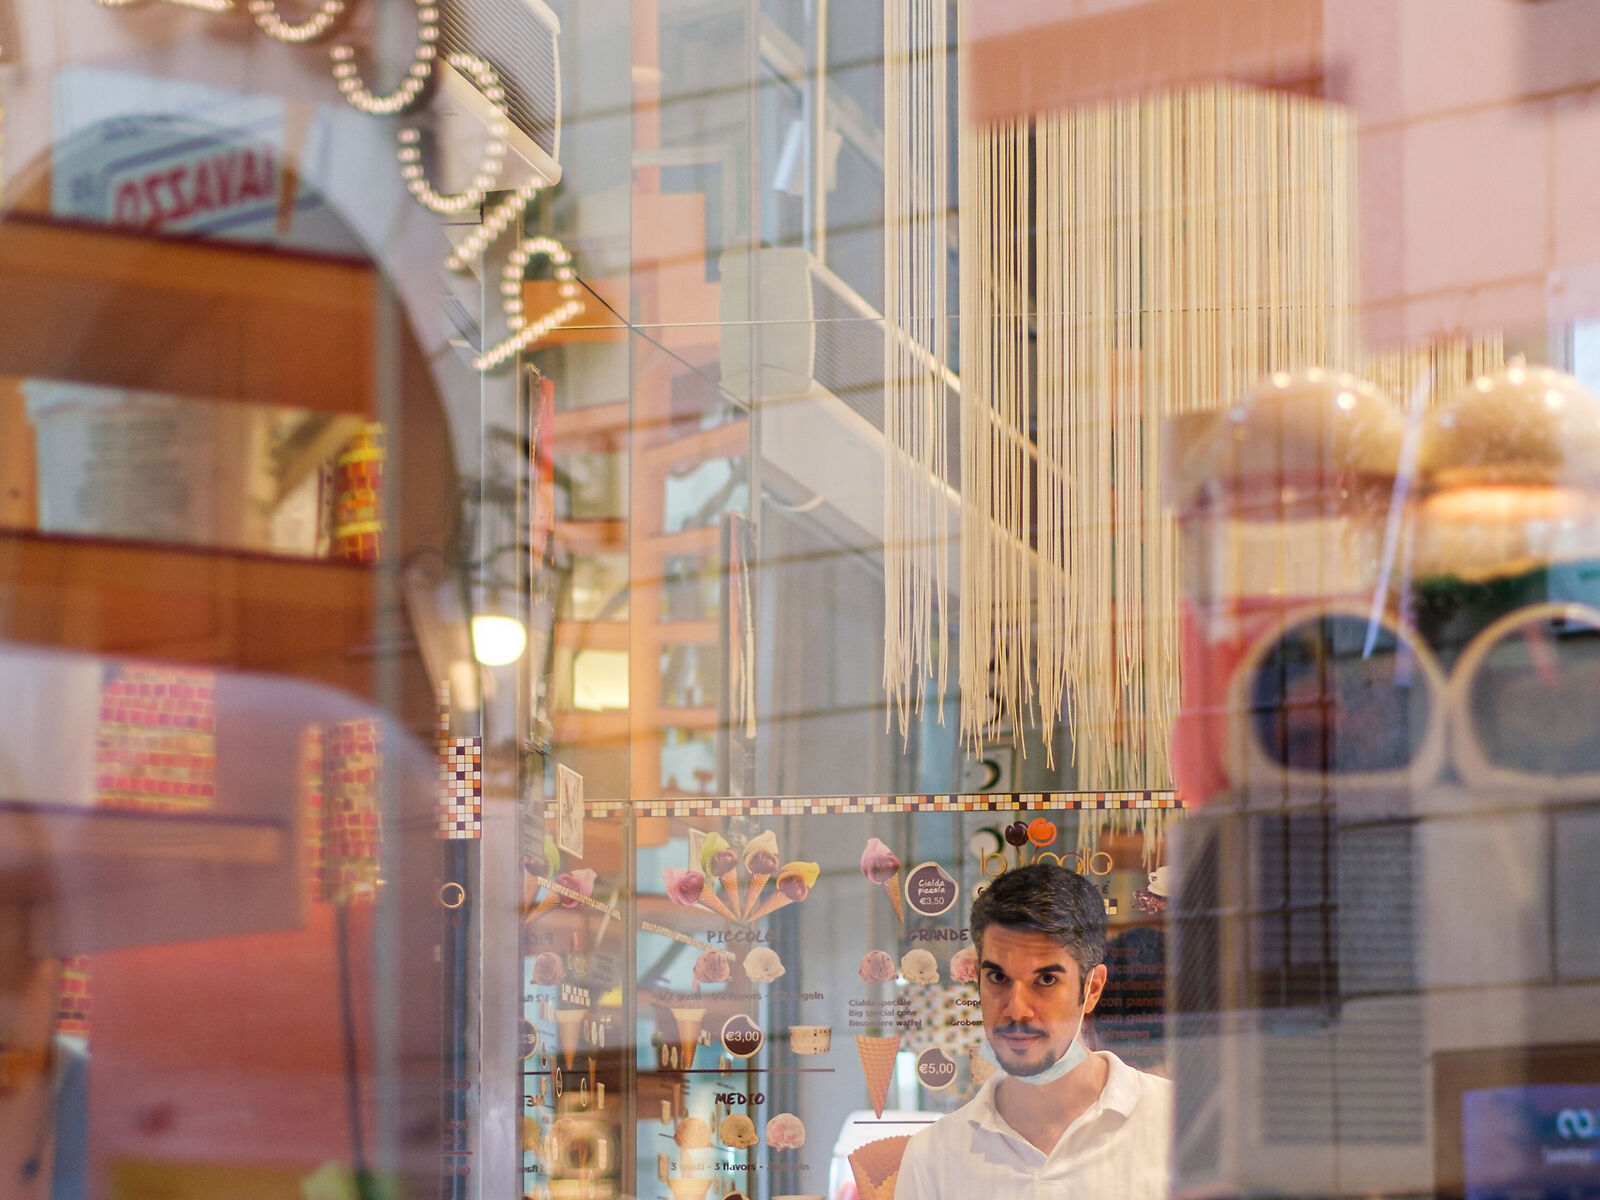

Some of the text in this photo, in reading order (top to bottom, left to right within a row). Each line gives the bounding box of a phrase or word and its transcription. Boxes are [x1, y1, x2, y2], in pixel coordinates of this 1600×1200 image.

[918, 879, 945, 887] Cialda
[917, 886, 946, 896] piccola
[919, 896, 945, 906] €3,50
[908, 928, 969, 942] GRANDE
[725, 1031, 760, 1044] €3,00
[919, 1062, 954, 1075] €5,00
[714, 1092, 766, 1105] MEDIO
[723, 1160, 757, 1171] flavors
